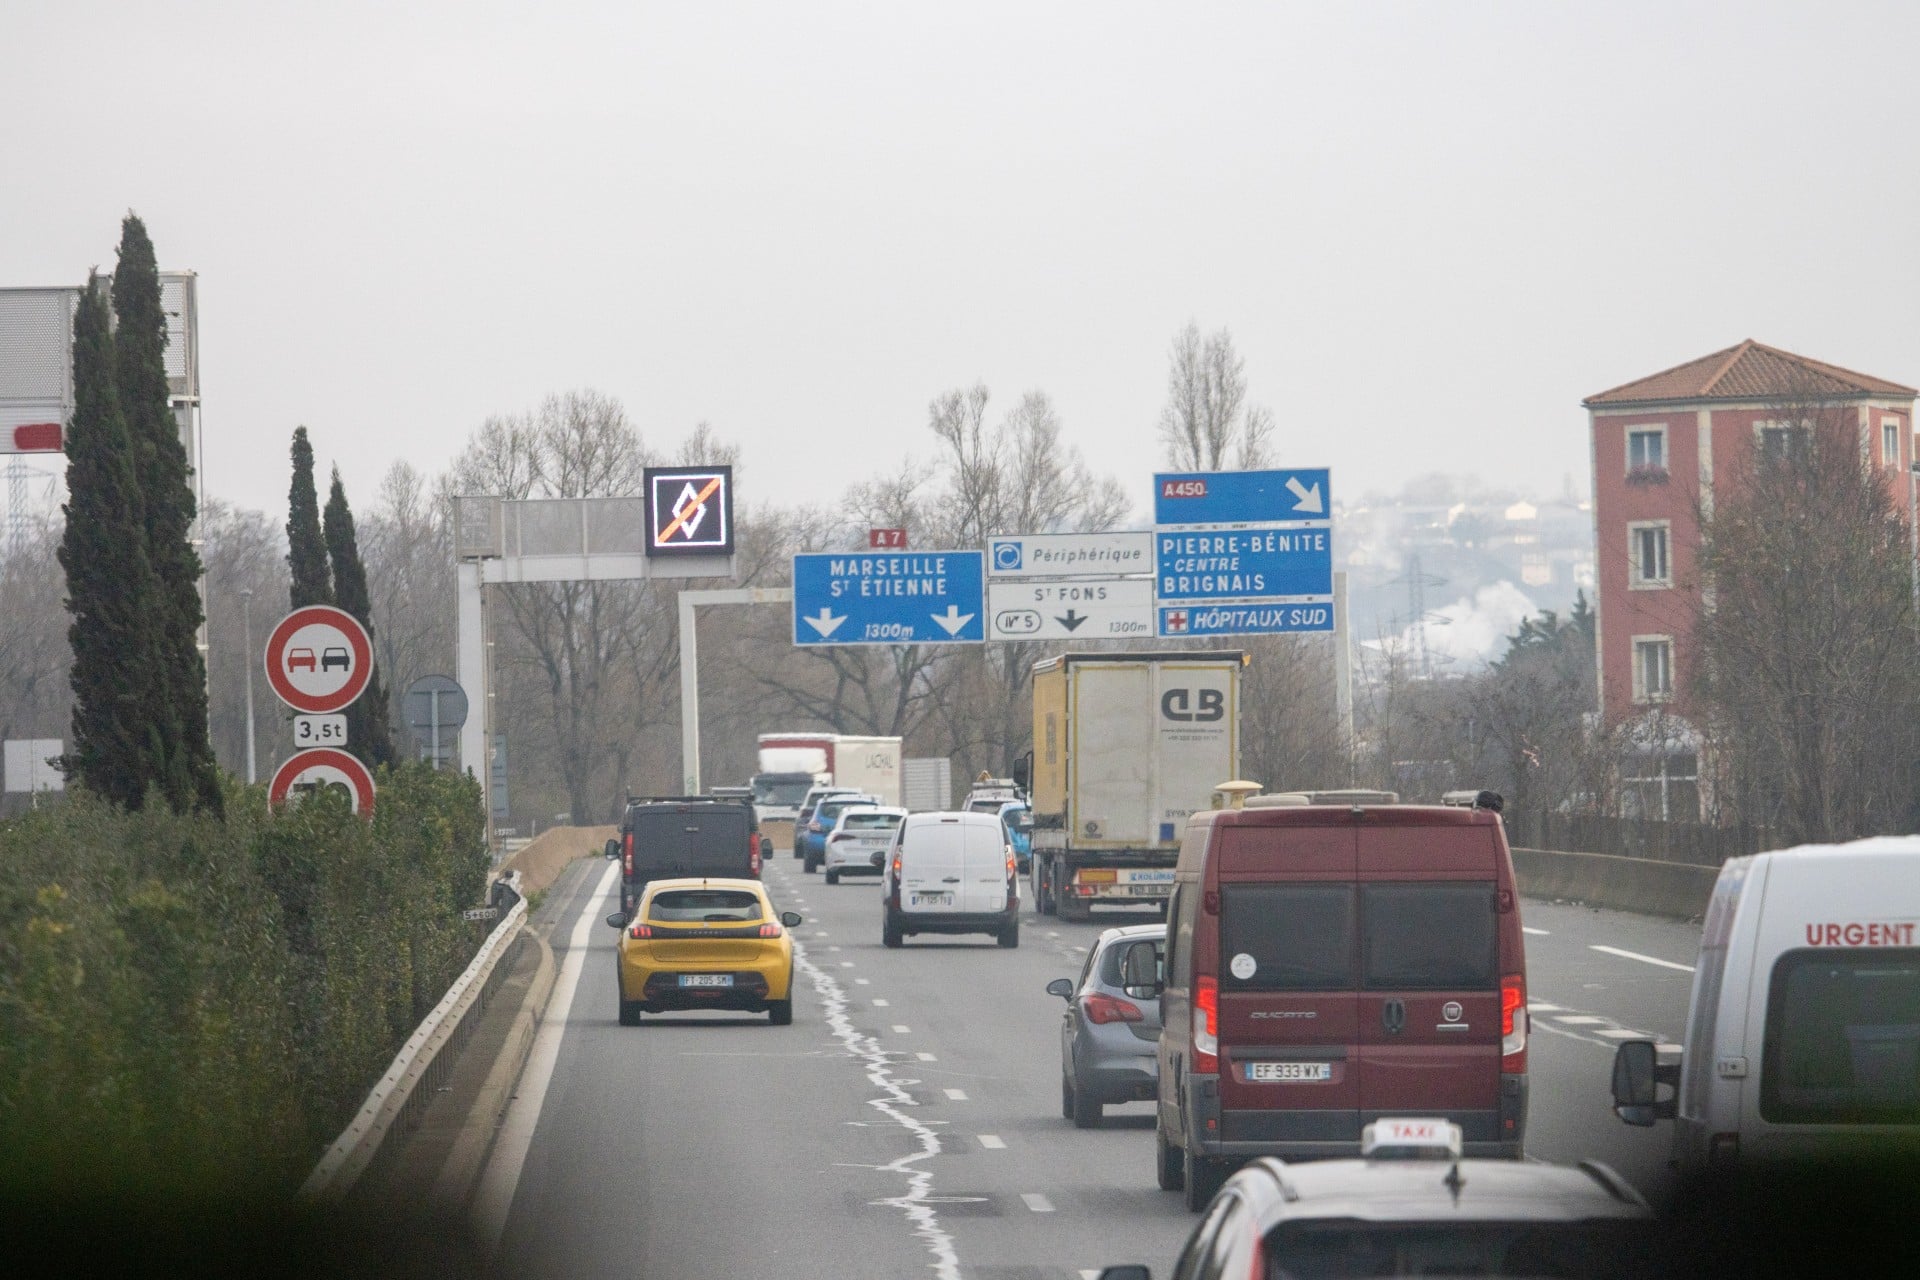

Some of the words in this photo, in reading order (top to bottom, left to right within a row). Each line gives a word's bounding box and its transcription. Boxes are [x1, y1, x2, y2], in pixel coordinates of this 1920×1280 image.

[1164, 482, 1205, 497] A450
[1162, 532, 1325, 555] PIERRE-BÉNITE
[1032, 548, 1142, 565] Périphérique
[829, 558, 947, 577] MARSEILLE
[860, 576, 947, 597] ÉTIENNE
[1163, 574, 1266, 594] BRIGNAIS
[1058, 586, 1108, 601] FONS
[1108, 621, 1148, 634] 1300m
[1193, 607, 1285, 630] HÔPITAUX
[1289, 608, 1328, 626] SUD
[864, 623, 915, 638] 1300m
[1806, 923, 1915, 946] URGENT
[1391, 1124, 1435, 1138] TAXI
